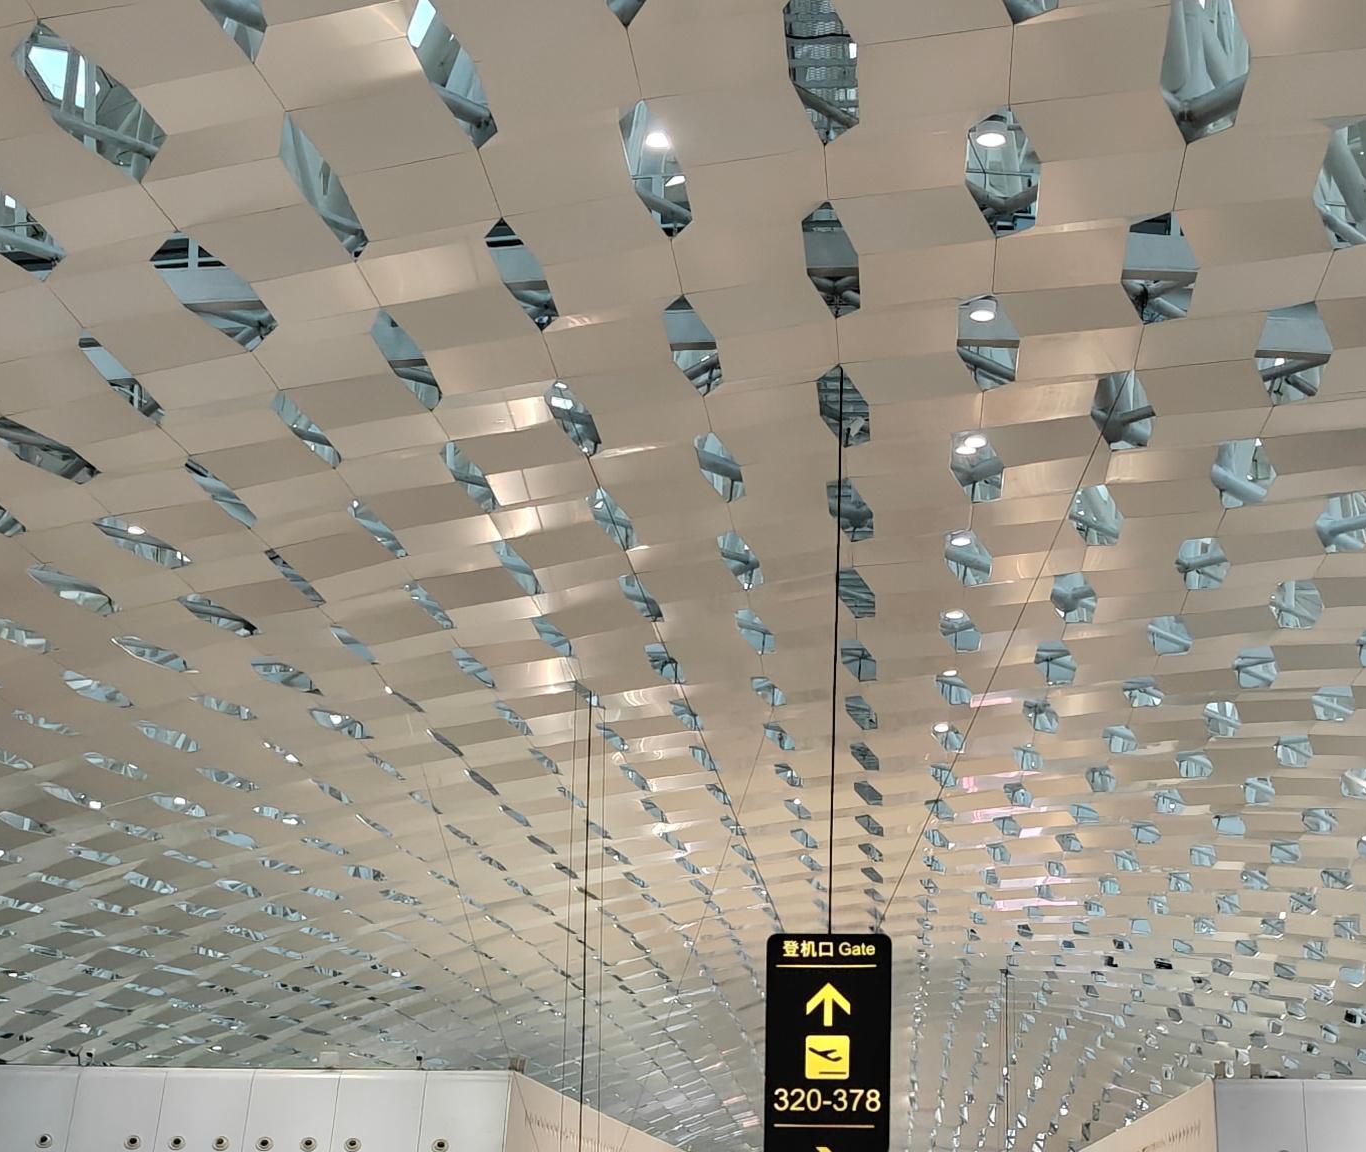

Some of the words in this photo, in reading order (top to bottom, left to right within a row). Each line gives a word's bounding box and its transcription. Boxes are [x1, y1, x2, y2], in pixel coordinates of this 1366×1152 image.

[782, 940, 834, 958] 登机口
[838, 942, 876, 957] Gate
[773, 1088, 881, 1113] 320-378
